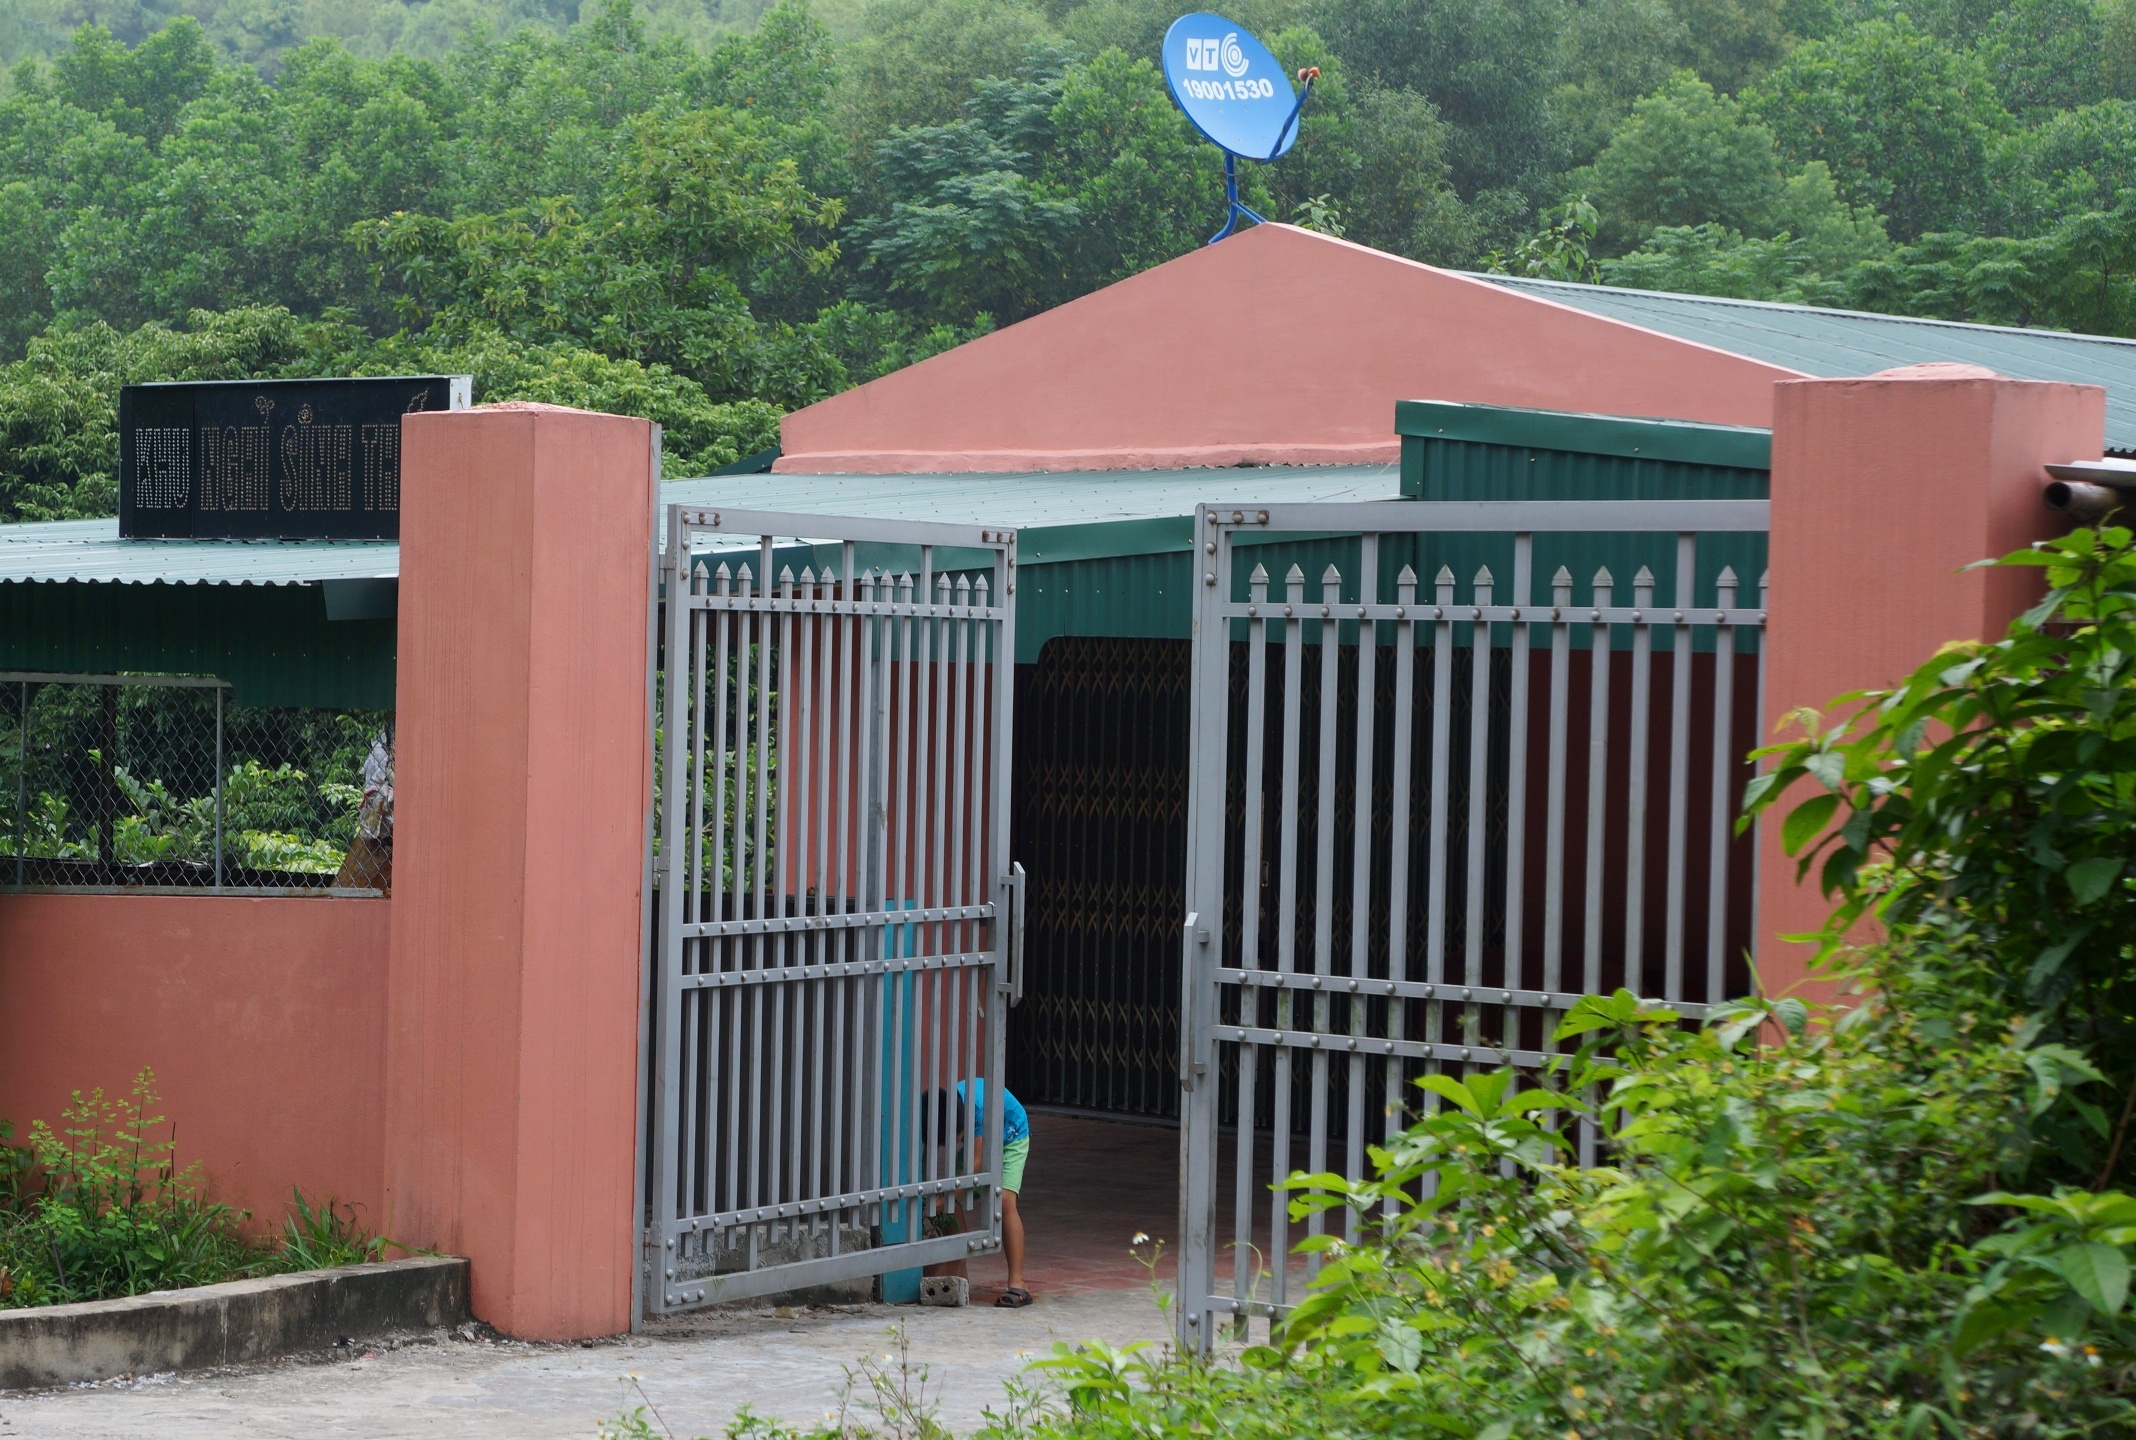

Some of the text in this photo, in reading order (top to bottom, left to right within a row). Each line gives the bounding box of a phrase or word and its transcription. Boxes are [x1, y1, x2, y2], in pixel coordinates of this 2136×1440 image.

[1186, 32, 1249, 78] VTC
[1182, 77, 1274, 101] 19001530
[136, 427, 190, 509] KHU
[280, 424, 352, 512] SINH
[361, 423, 399, 511] TH
